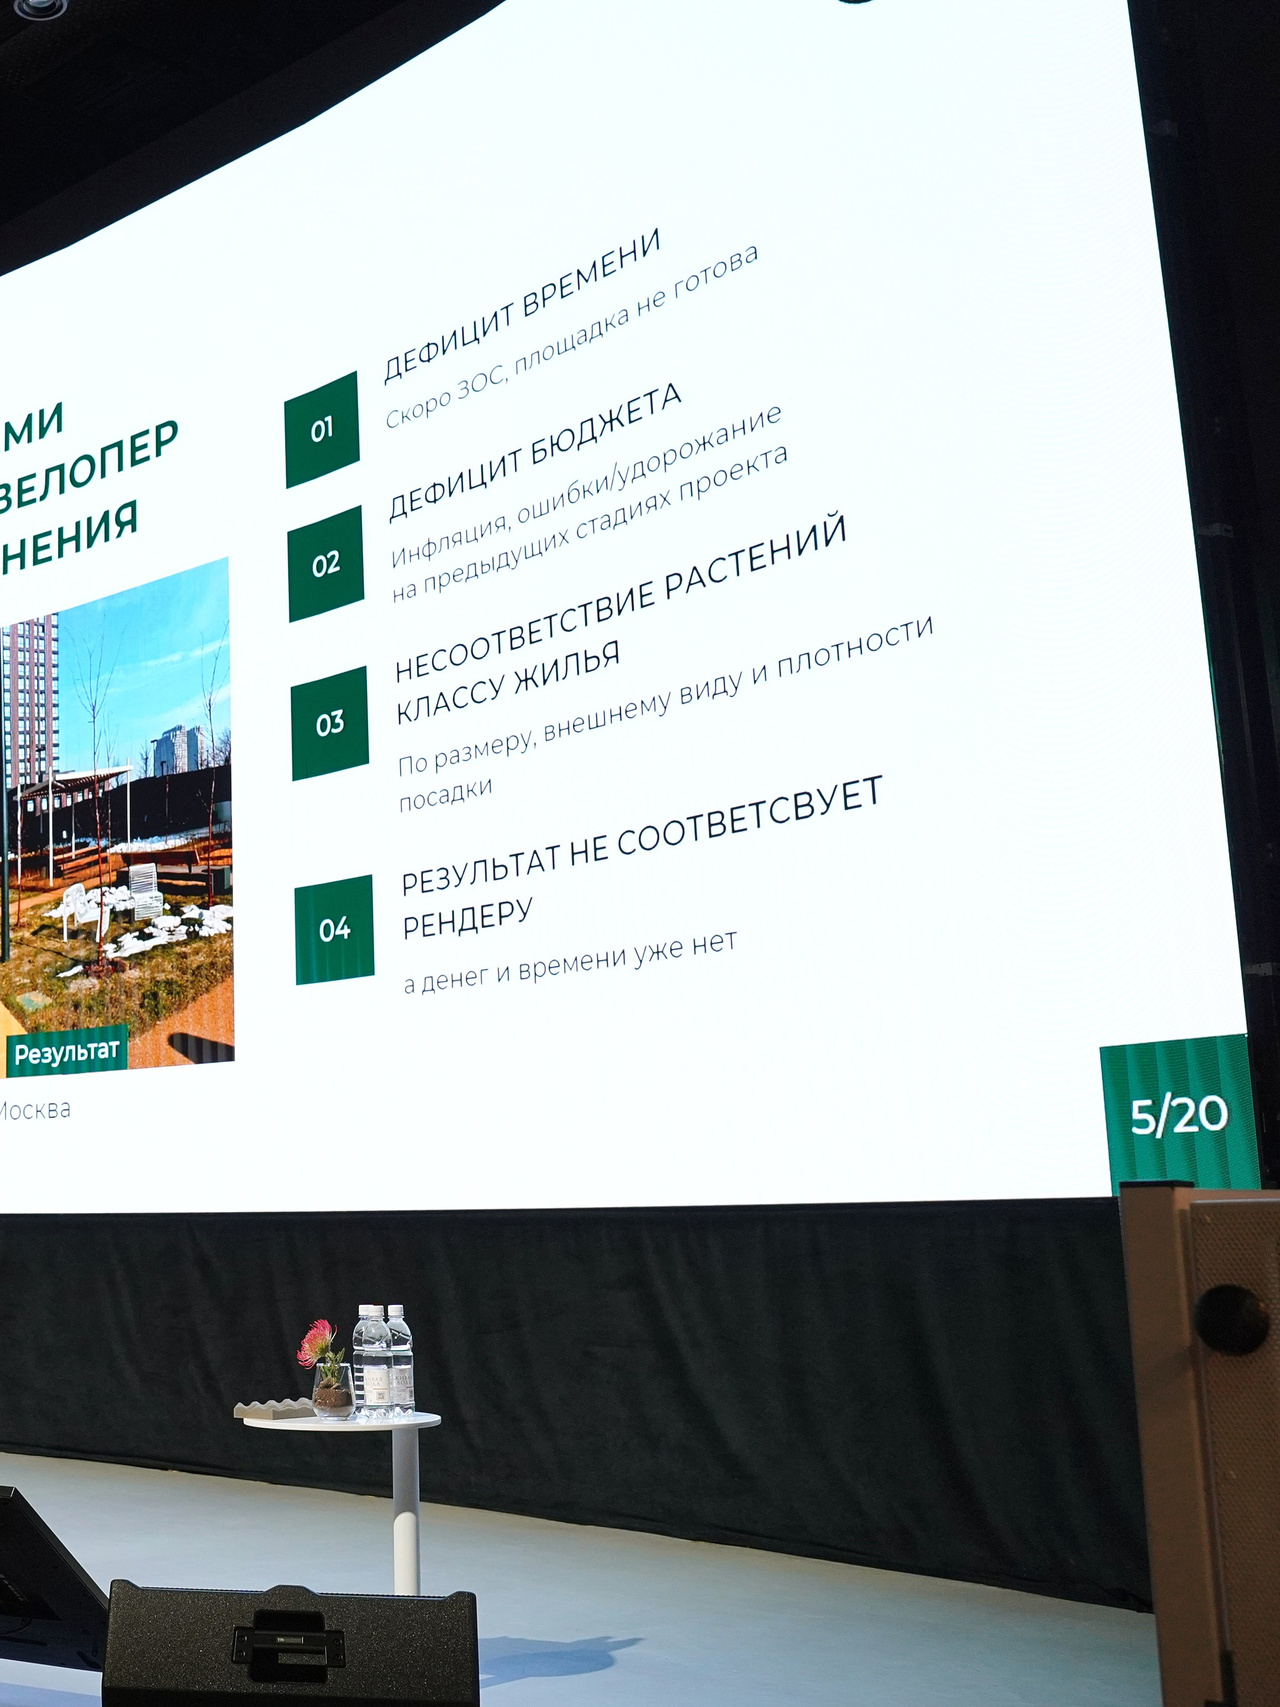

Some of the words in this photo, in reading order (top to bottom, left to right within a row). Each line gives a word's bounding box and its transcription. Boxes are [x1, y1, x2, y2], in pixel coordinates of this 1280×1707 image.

[384, 302, 514, 386] ДЕФИЦИТ
[524, 228, 659, 317] ВРЕМЕНИ
[387, 392, 451, 428] Скоро
[516, 309, 628, 375] площадка
[638, 291, 665, 316] не
[675, 246, 757, 299] готова
[312, 416, 332, 442] 01
[389, 448, 522, 524] ДЕФИЦИТ
[532, 383, 682, 465] БЮДЖЕТА
[393, 516, 511, 568] Инфляция,
[518, 406, 781, 523] ошибки/удорожание
[394, 584, 416, 603] на
[425, 529, 569, 593] предыдущих
[577, 490, 671, 539] стадиях
[680, 446, 787, 501] проекта
[313, 551, 340, 577] 02
[397, 581, 655, 683] НЕСООТВЕТСТВИЕ
[666, 510, 846, 600] РАСТЕНИЙ
[398, 674, 505, 725] КЛАССУ
[514, 640, 619, 694] ЖИЛЬЯ
[399, 756, 427, 777] По
[435, 731, 536, 774] размеру,
[545, 692, 671, 742] внешнему
[680, 671, 742, 704] виду
[753, 665, 767, 684] и
[778, 616, 933, 677] плотности
[317, 710, 343, 736] 03
[400, 779, 491, 813] посадки
[403, 845, 560, 896] РЕЗУЛЬТАТ
[571, 835, 608, 866] НЕ
[618, 775, 883, 855] СООТВЕТСВУЕТ
[320, 916, 350, 942] 04
[404, 897, 533, 940] РЕНДЕРУ
[405, 979, 414, 994] а
[422, 969, 488, 995] денег
[498, 966, 509, 982] и
[520, 949, 625, 984] времени
[634, 941, 683, 970] уже
[693, 932, 737, 955] нет
[16, 1041, 119, 1067] Результат
[1133, 1093, 1227, 1138] 5/20
